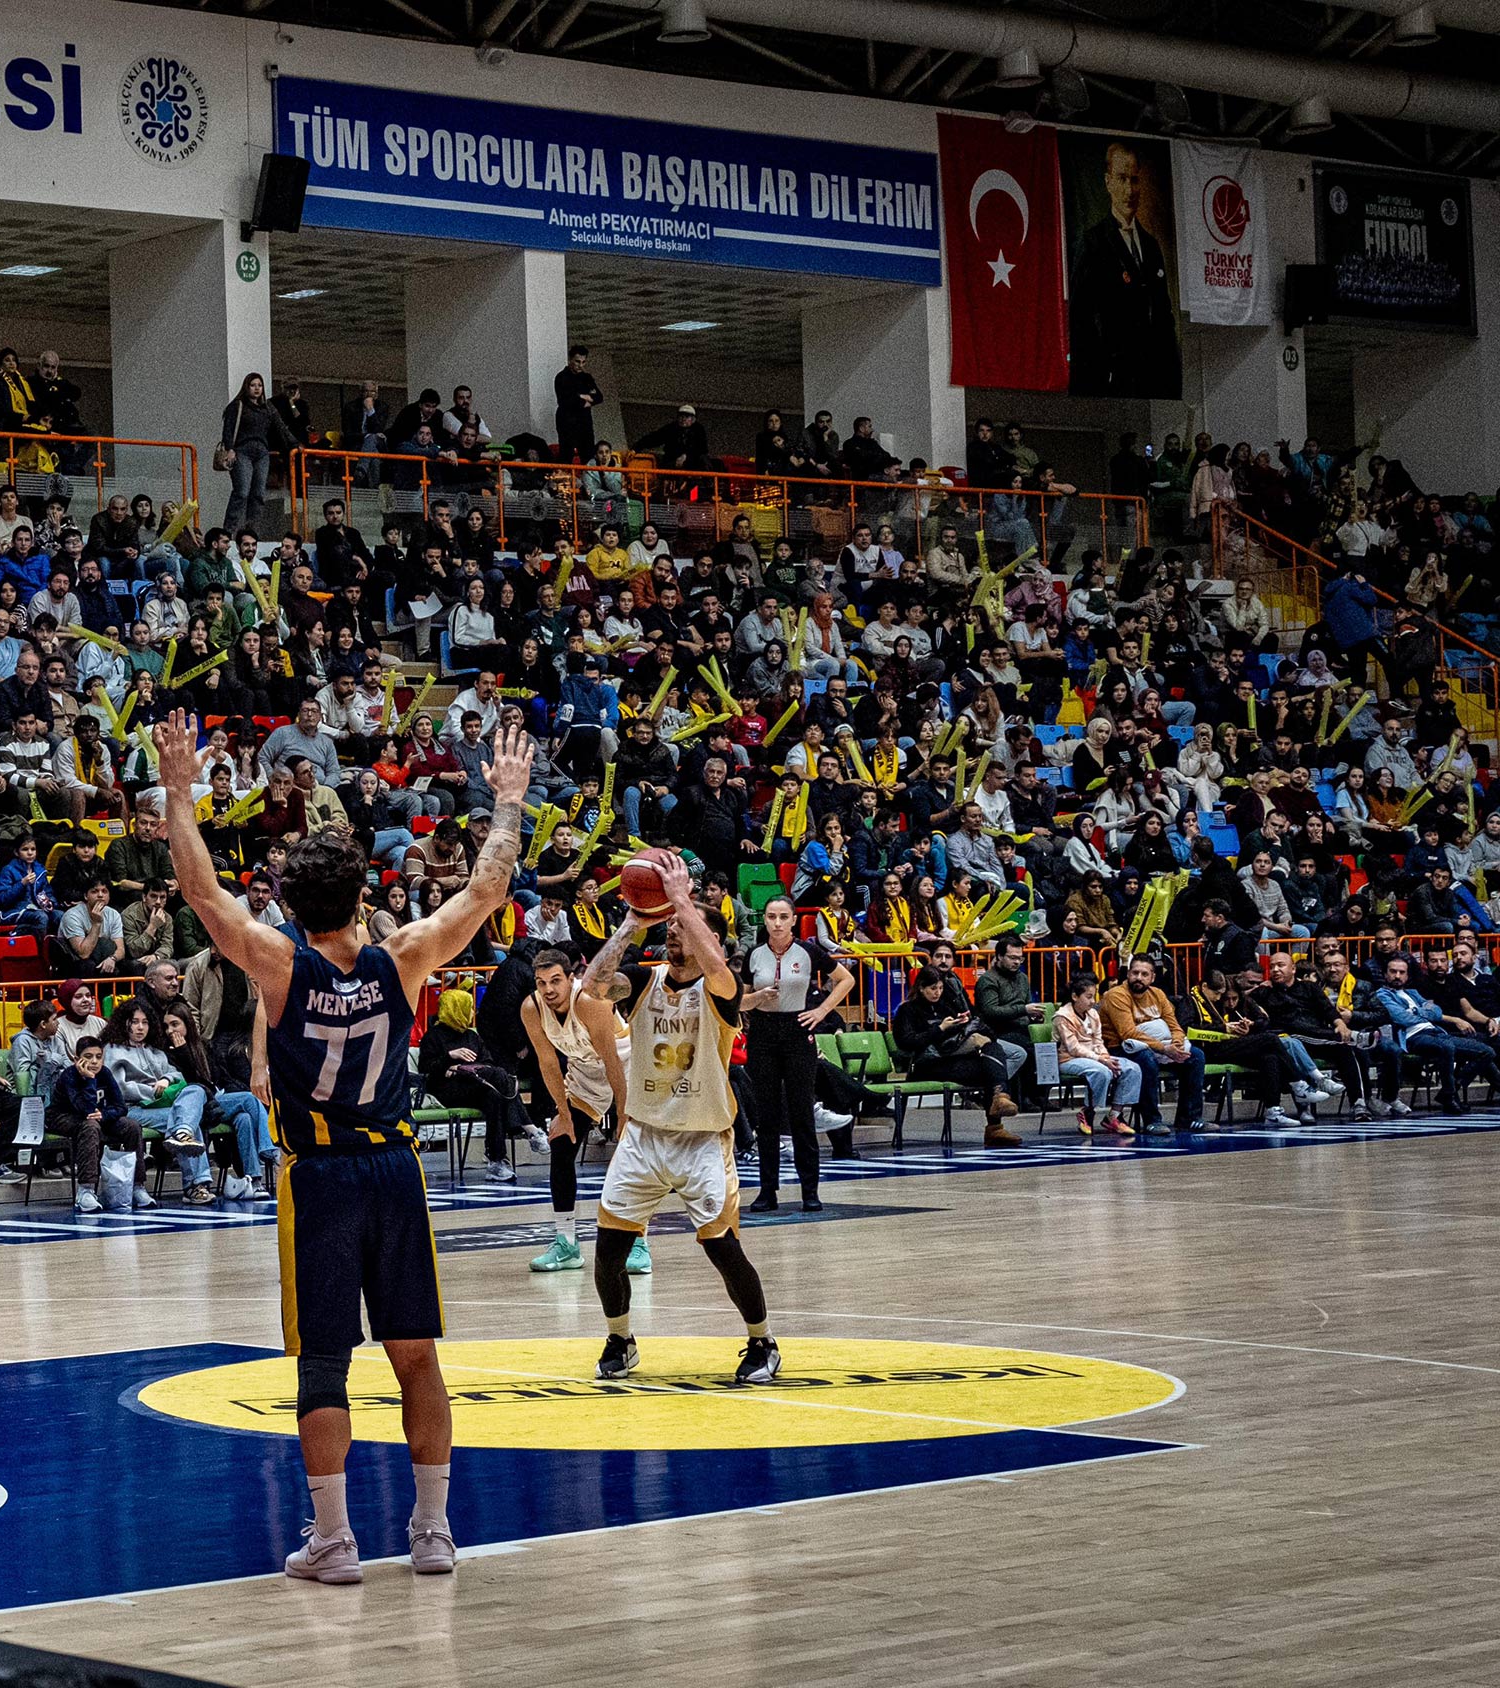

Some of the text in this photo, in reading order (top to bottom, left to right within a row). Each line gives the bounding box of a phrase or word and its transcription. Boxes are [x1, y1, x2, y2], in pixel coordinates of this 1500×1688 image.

[135, 137, 198, 163] KONYA 1989
[288, 106, 370, 171] TÜM
[384, 124, 610, 197] SPORCULARA
[622, 151, 799, 216] BAŞARILAR
[549, 207, 711, 240] Ahmet PEKYATIRMACI
[571, 230, 691, 252] Selçuklu Belediye Başkanı
[240, 255, 257, 271] C3
[1204, 249, 1252, 268] TÜRKİYE
[653, 1017, 700, 1034] KONYA
[303, 1012, 390, 1105] 77
[653, 1042, 695, 1070] 98
